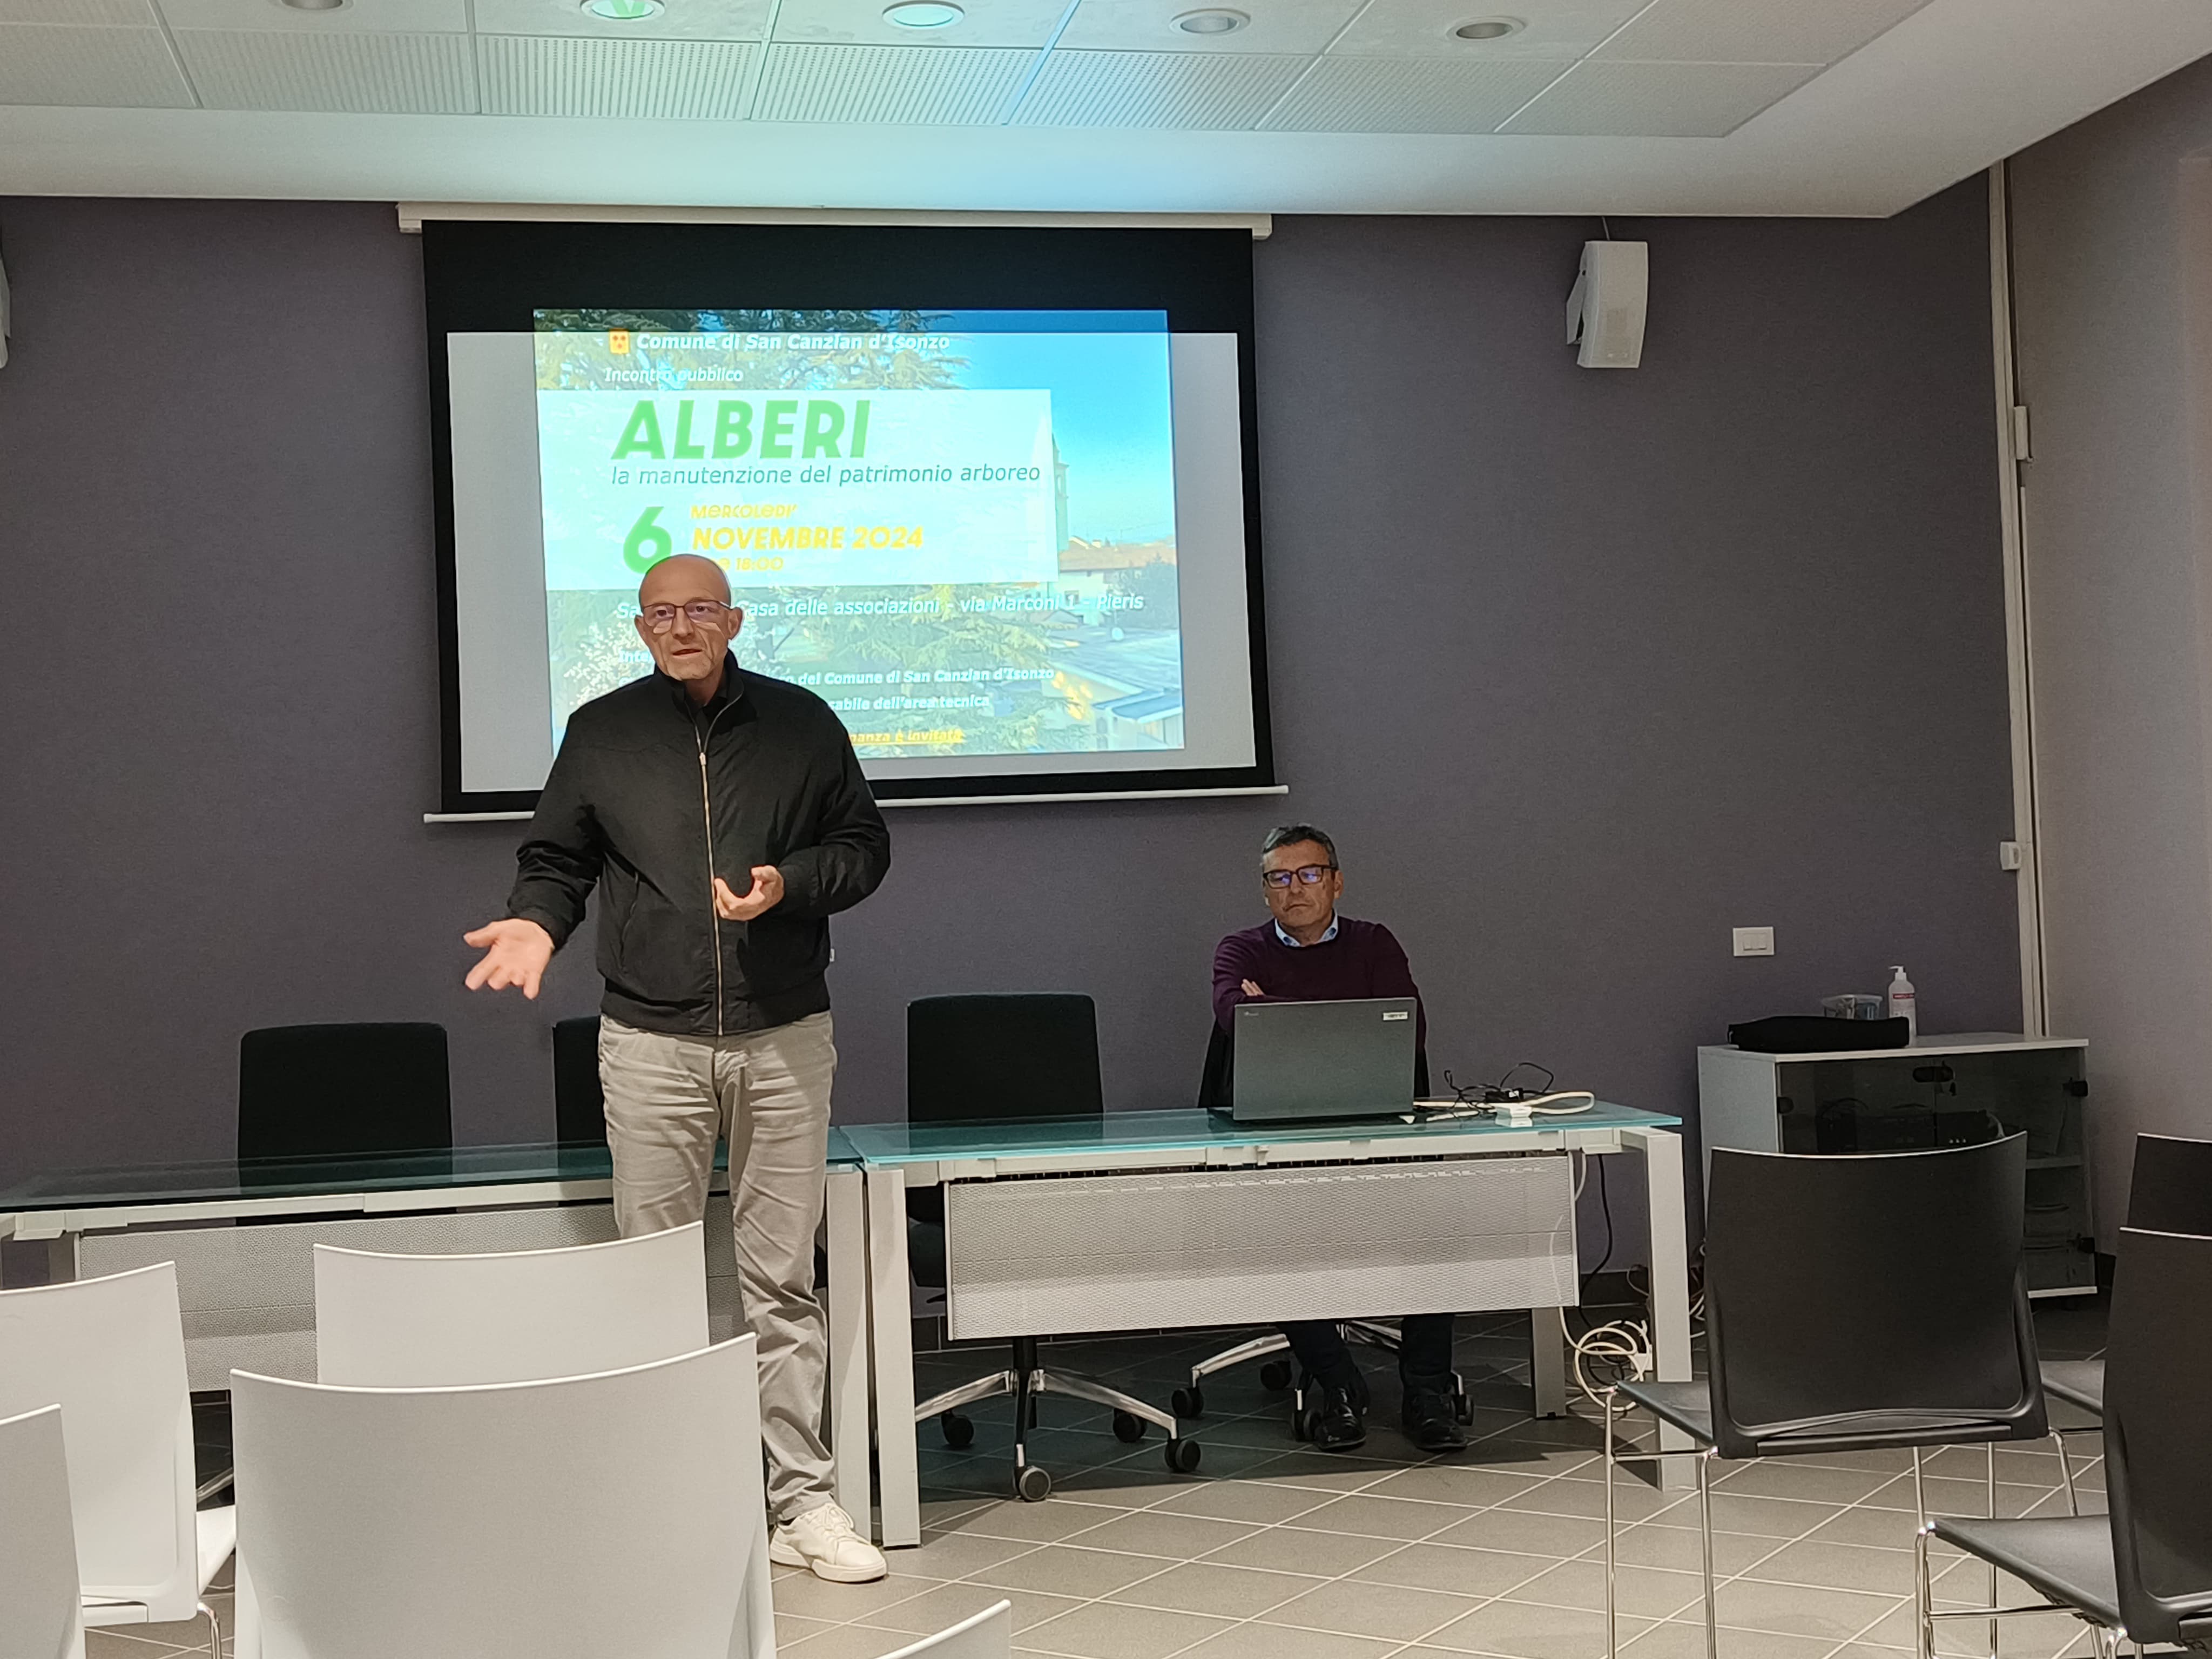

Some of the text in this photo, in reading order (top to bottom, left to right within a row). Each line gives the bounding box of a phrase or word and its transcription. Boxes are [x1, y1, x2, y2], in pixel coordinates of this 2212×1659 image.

[636, 333, 950, 350] Comune di San Canzian d'Isonzo
[605, 367, 743, 384] Incontro pubblico
[610, 400, 870, 460] ALBERI
[612, 464, 1041, 484] la manutenzione del patrimonio arboreo
[623, 506, 673, 574] 6
[692, 526, 924, 550] NOVEMBRE 2024
[736, 557, 784, 571] 18:00
[785, 598, 828, 615] delle
[833, 597, 940, 615] associazioni
[960, 596, 986, 613] via
[992, 594, 1059, 611] Marconi
[1097, 593, 1144, 611] Pieris
[798, 672, 821, 685] del
[825, 672, 882, 685] Comune
[886, 671, 900, 683] di
[903, 671, 930, 683] San
[934, 669, 990, 682] Canzian
[993, 667, 1054, 681] d'Isonzo
[873, 696, 937, 710] dell'area
[939, 694, 990, 708] tecnica
